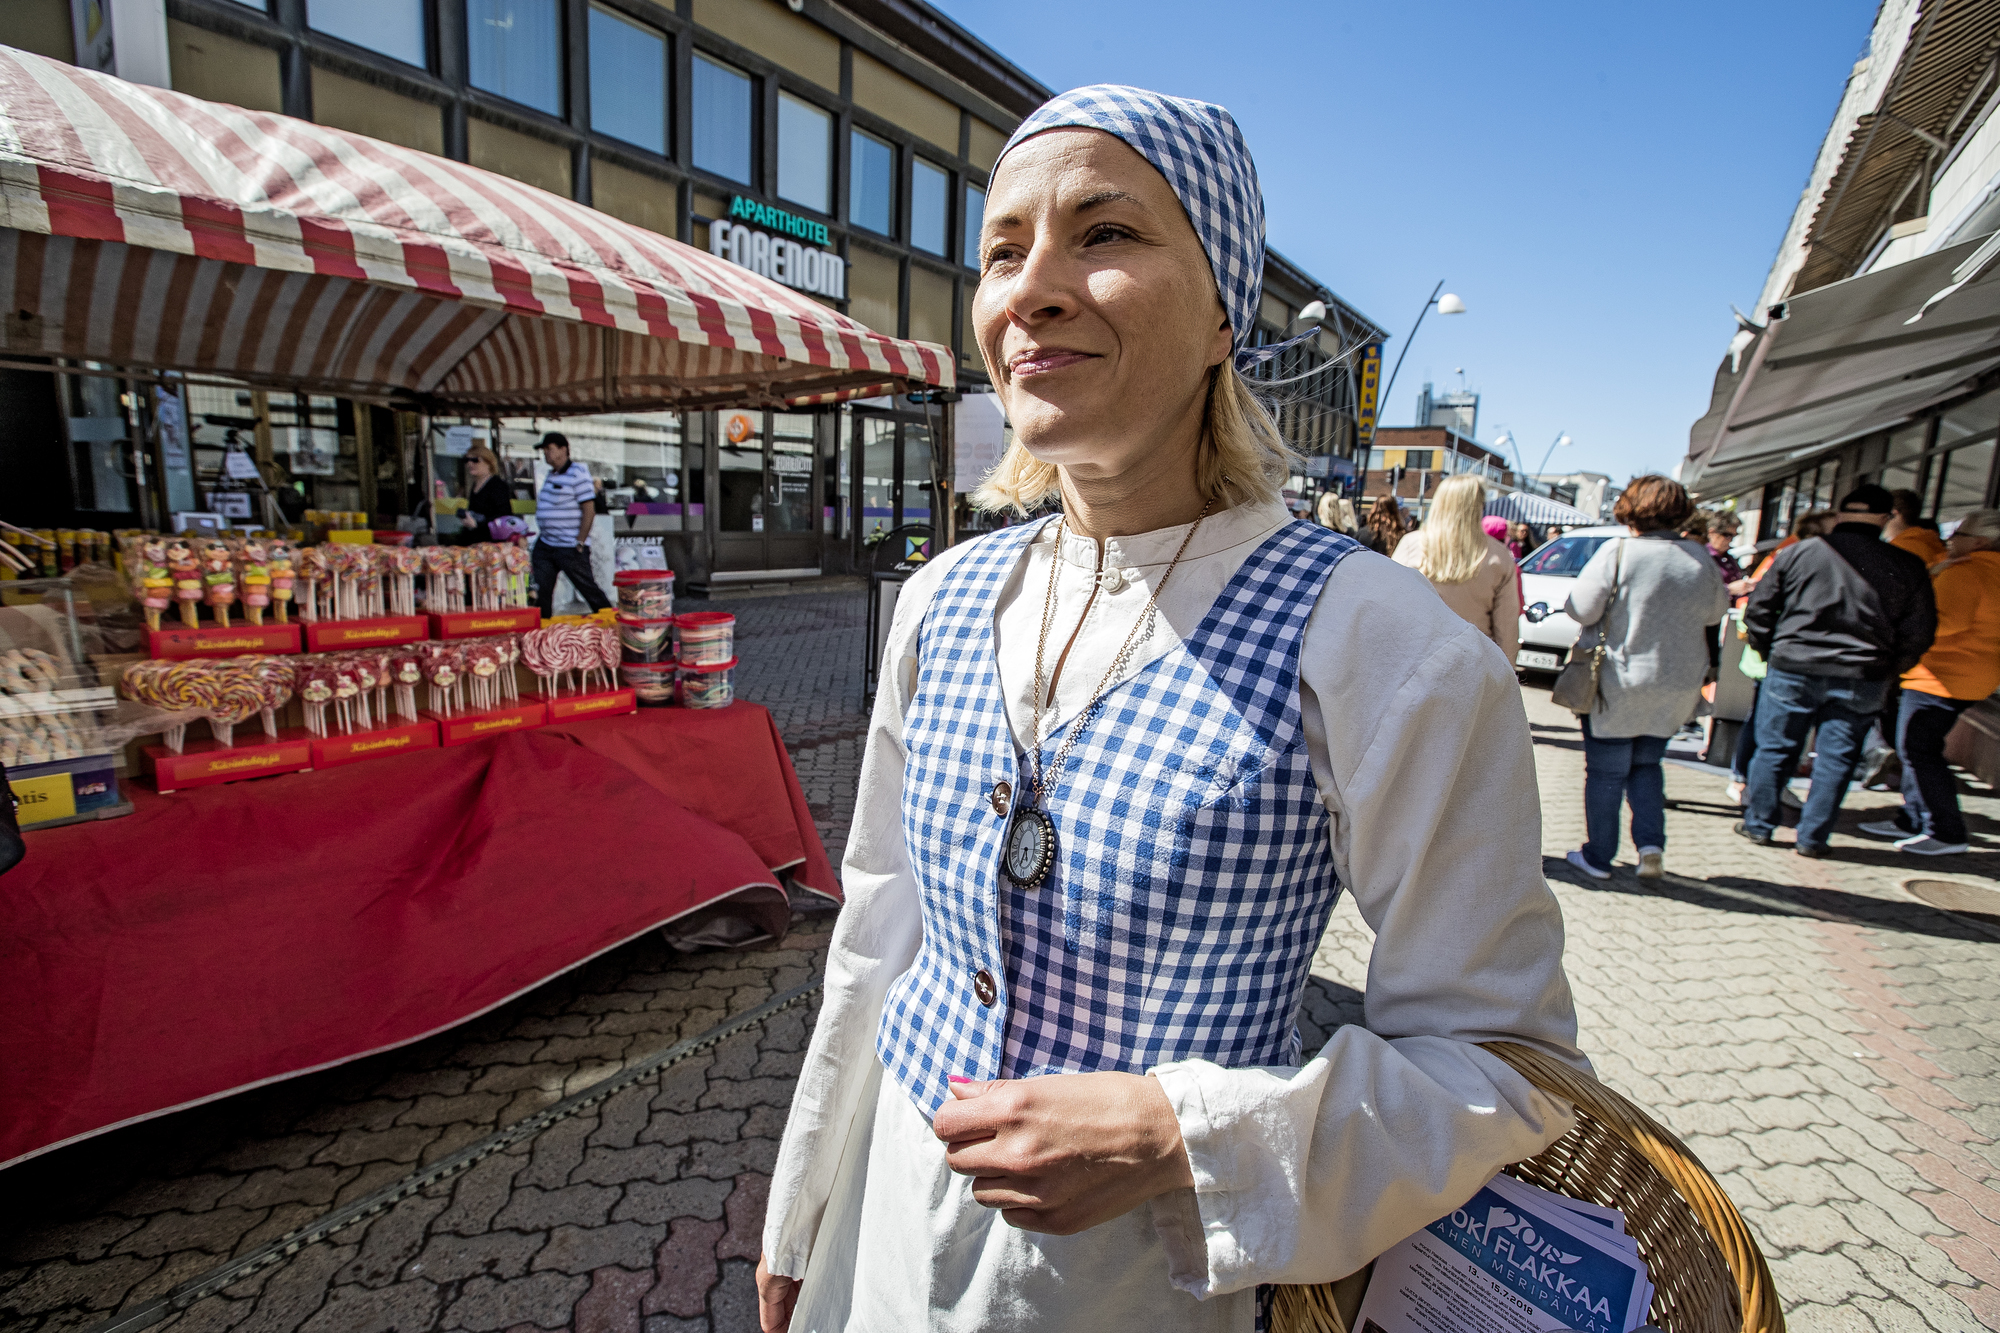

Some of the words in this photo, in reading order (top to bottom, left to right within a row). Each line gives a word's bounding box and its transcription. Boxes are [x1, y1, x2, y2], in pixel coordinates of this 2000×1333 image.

[730, 194, 831, 246] APARTHOTEL
[709, 218, 845, 299] FORENOM
[1361, 362, 1376, 432] KULMA
[1435, 1221, 1483, 1258] AHEN
[1466, 1264, 1481, 1280] 13.
[1490, 1280, 1534, 1317] 15.7.2018
[1494, 1235, 1612, 1323] FLAKKAA
